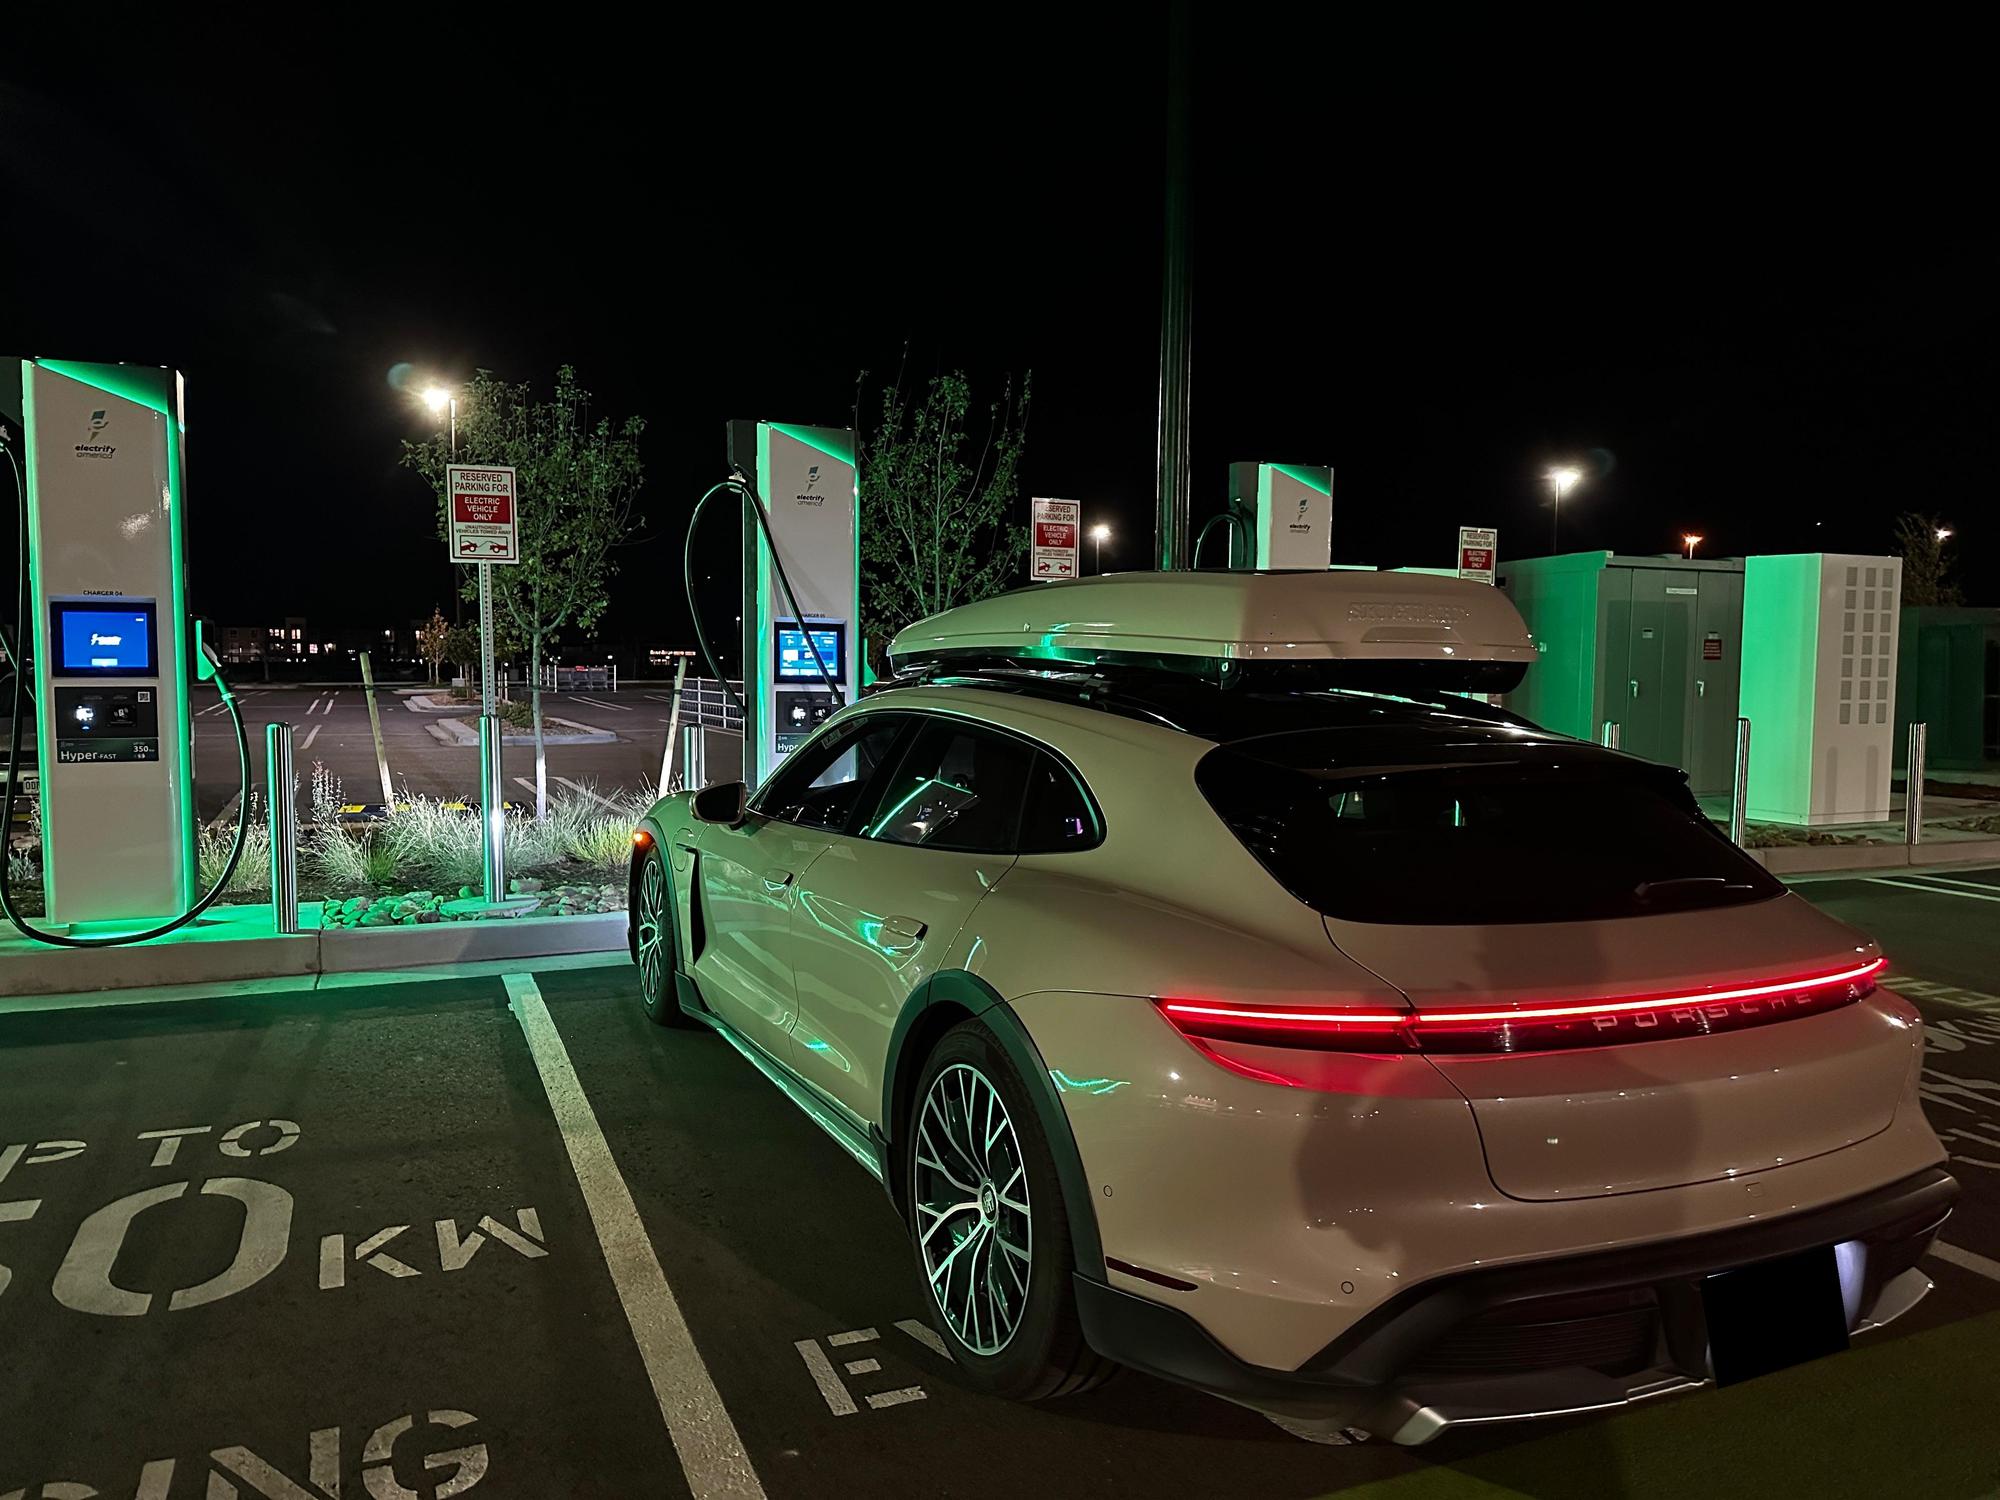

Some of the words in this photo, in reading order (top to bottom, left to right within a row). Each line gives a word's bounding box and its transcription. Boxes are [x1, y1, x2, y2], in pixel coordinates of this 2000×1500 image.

[75, 444, 116, 454] electrify
[460, 472, 503, 482] RESERVED
[455, 482, 490, 492] PARKING
[492, 484, 509, 493] FOR
[464, 496, 501, 505] ELECTRIC
[796, 494, 824, 502] electrify
[467, 505, 498, 513] VEHICLE
[473, 513, 493, 521] ONLY
[133, 745, 149, 753] 350
[138, 1119, 300, 1167] TO
[319, 1207, 549, 1289] KW
